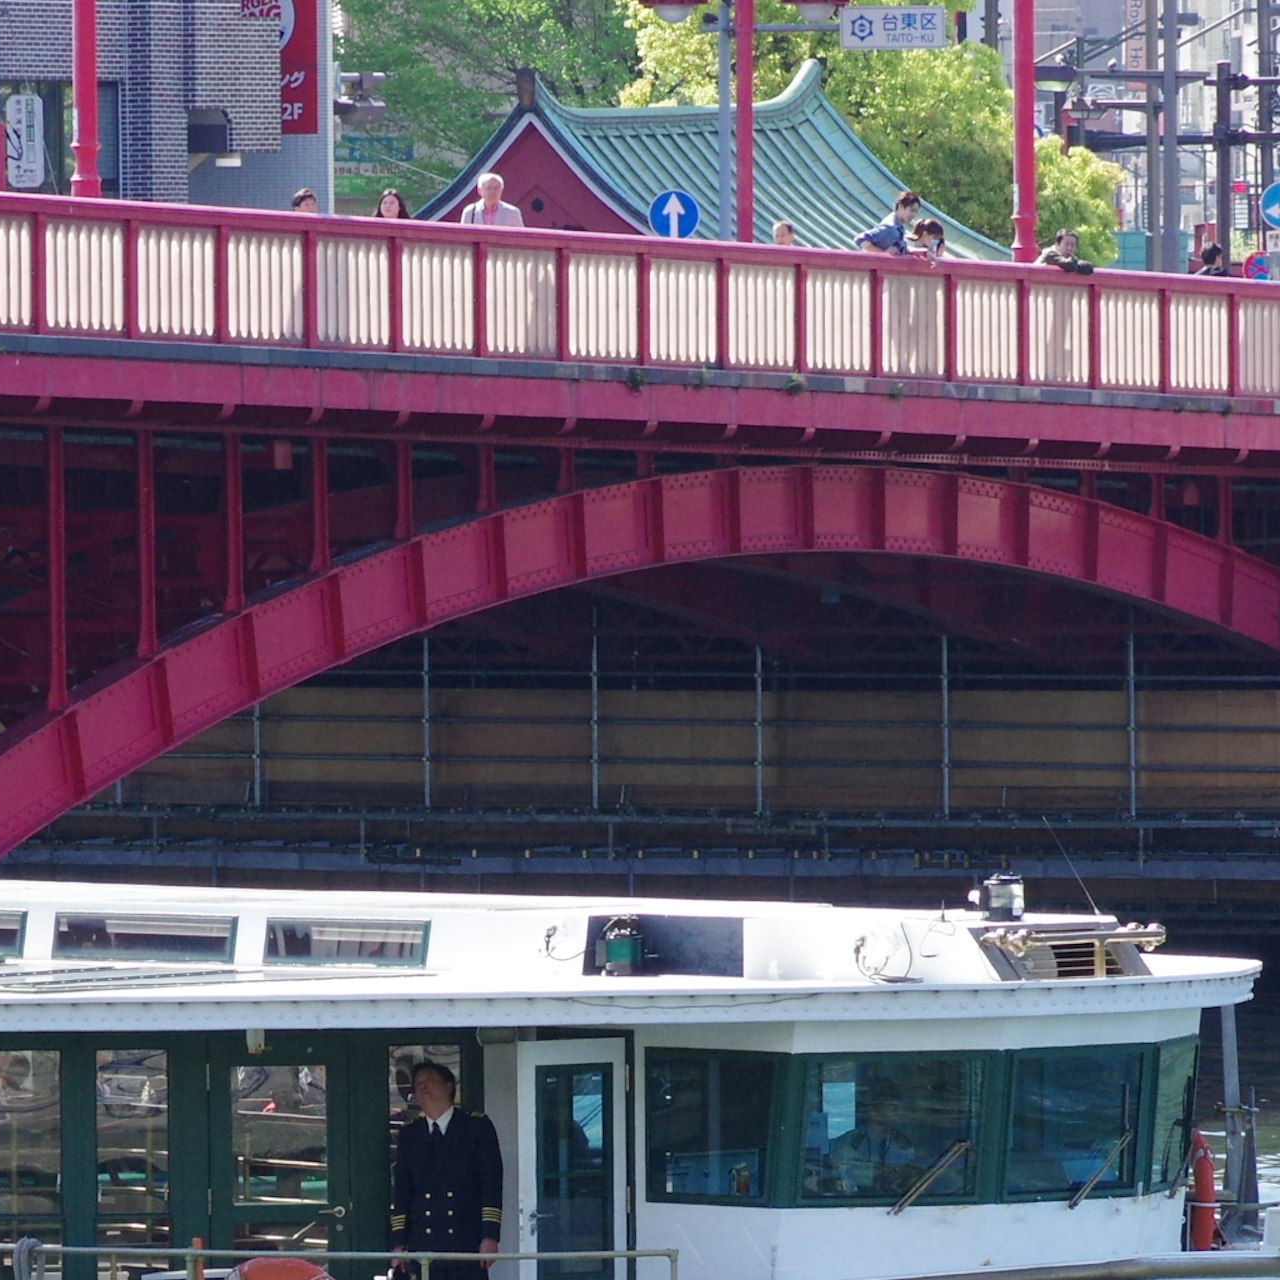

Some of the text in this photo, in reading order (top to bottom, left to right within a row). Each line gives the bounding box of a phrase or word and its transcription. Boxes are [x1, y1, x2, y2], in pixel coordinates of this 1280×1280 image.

[881, 12, 937, 31] 台東区
[1128, 0, 1143, 40] Royl
[886, 33, 934, 43] TAITO-KU
[282, 103, 304, 120] 2F
